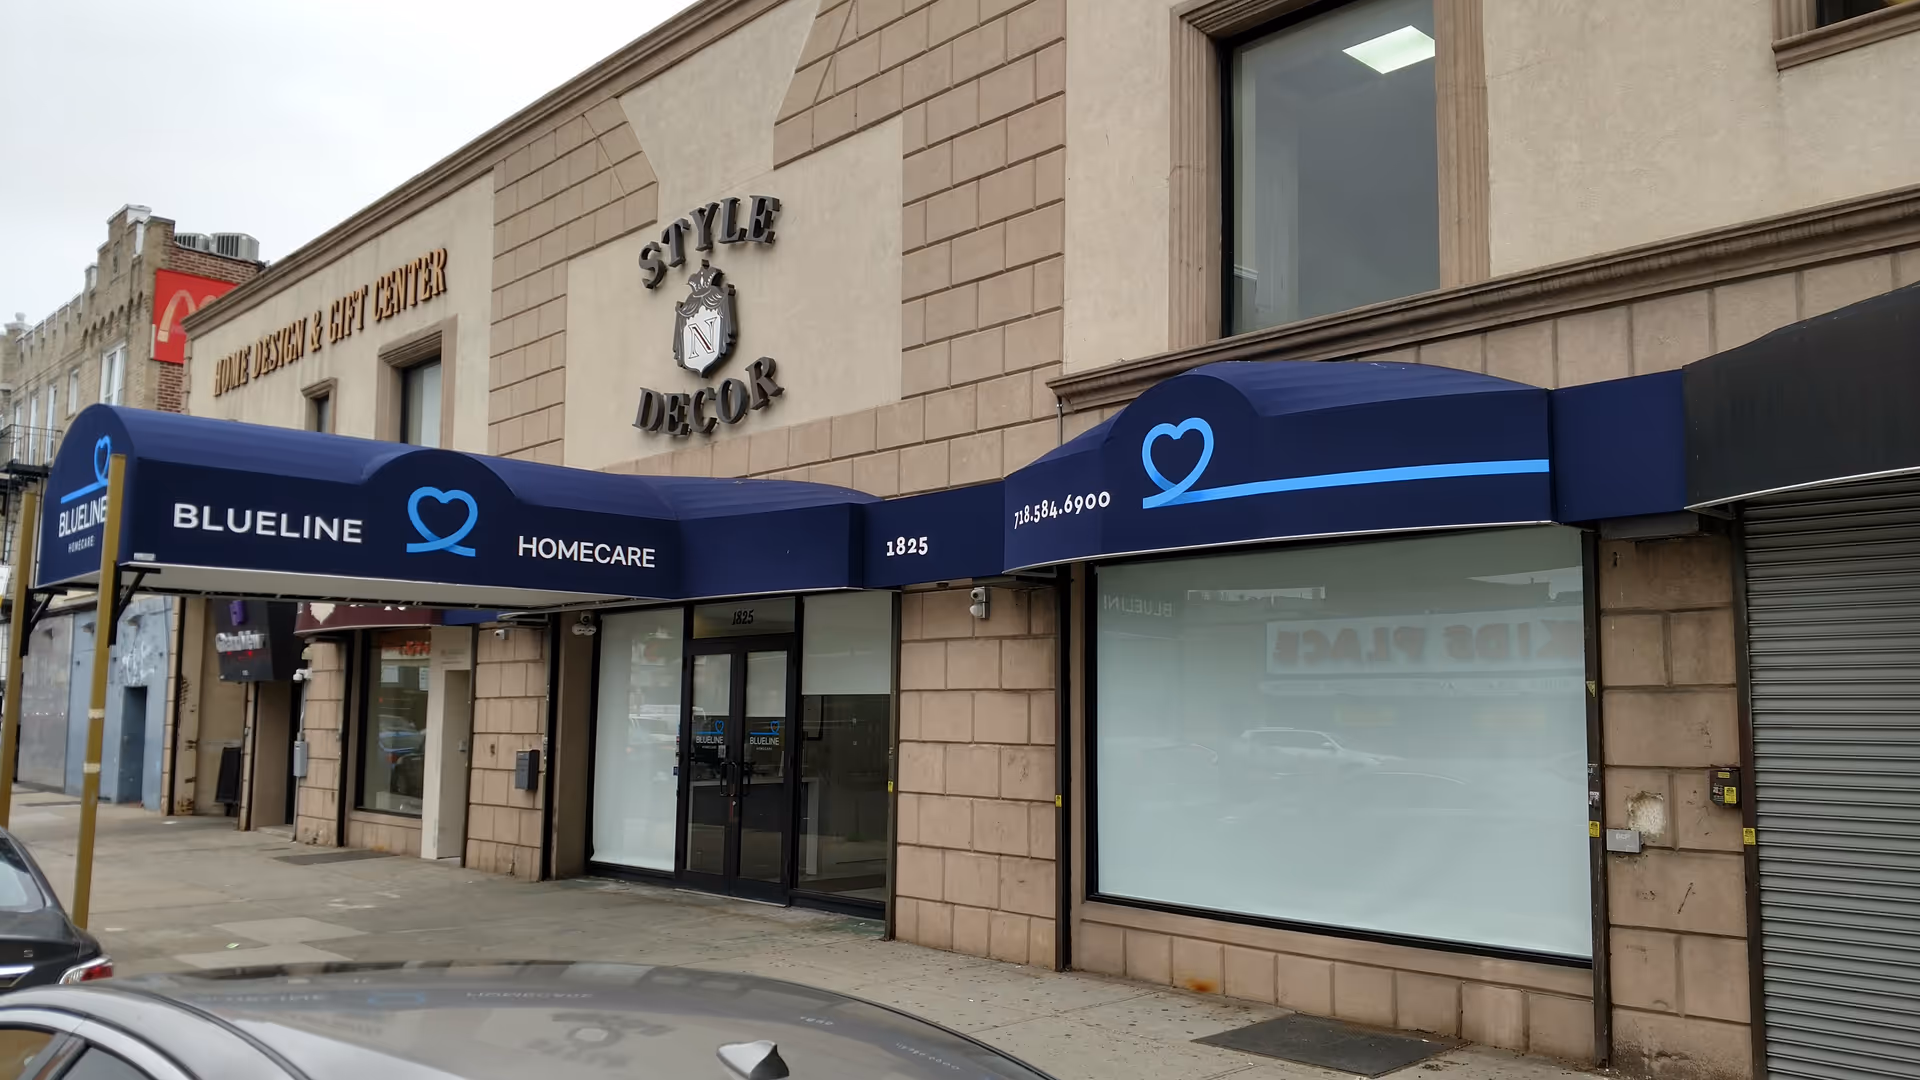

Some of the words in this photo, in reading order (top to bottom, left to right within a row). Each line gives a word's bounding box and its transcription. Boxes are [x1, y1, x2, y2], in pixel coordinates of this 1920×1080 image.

[638, 195, 781, 290] STYLE
[213, 346, 251, 398] HOME
[252, 317, 307, 380] DESIGN
[309, 310, 323, 352] &
[328, 284, 369, 345] GIFT
[372, 248, 448, 322] CENTER
[688, 316, 718, 359] N
[632, 356, 785, 436] DECOR
[58, 495, 108, 538] BLUELINE
[173, 502, 364, 544] BLUELINE
[1013, 490, 1112, 530] 718.584.6900
[518, 535, 656, 568] HOMECARE
[886, 536, 929, 557] 1825
[731, 609, 754, 626] 1825
[695, 735, 724, 744] BLUELINE
[749, 736, 780, 746] BLUELINE
